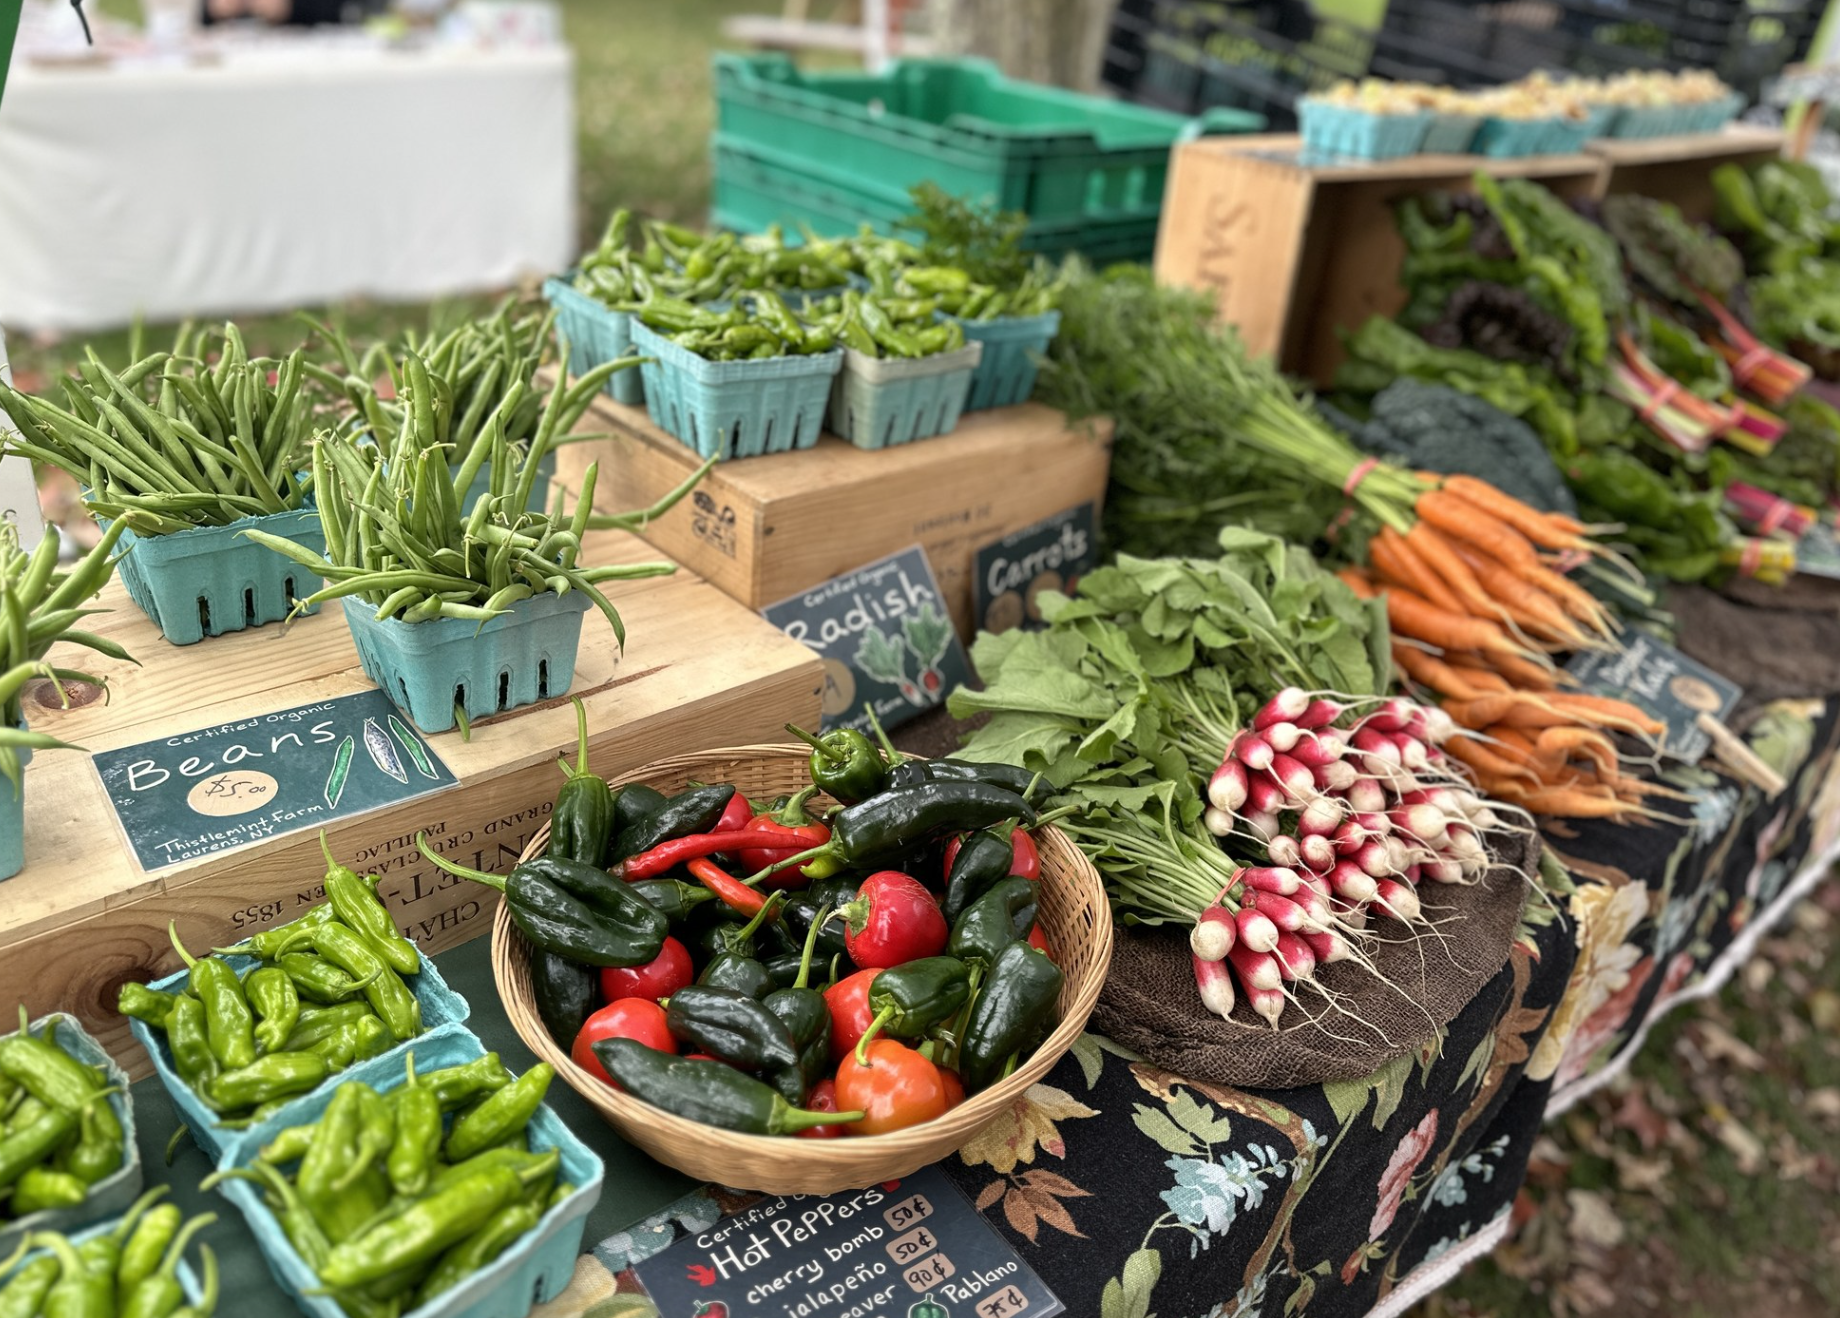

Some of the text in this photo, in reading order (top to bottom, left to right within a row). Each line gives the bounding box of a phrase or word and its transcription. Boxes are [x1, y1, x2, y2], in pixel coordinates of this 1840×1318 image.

[987, 523, 1088, 596] Carrots
[784, 570, 934, 649] Radish
[166, 703, 336, 747] Certified Organic
[127, 720, 336, 792] Beans
[205, 775, 267, 798] $5.00
[155, 804, 323, 853] Thistlemint Farm
[166, 825, 274, 864] Laurens, NY
[232, 801, 554, 930] GRAND CRU CLASS EN 1855
[403, 901, 480, 942] CHÂT
[697, 1195, 788, 1249] Certified
[709, 1233, 771, 1280] Hot
[746, 1259, 824, 1304] cherry
[824, 1226, 884, 1262] bomb
[940, 1261, 1018, 1304] Pablano
